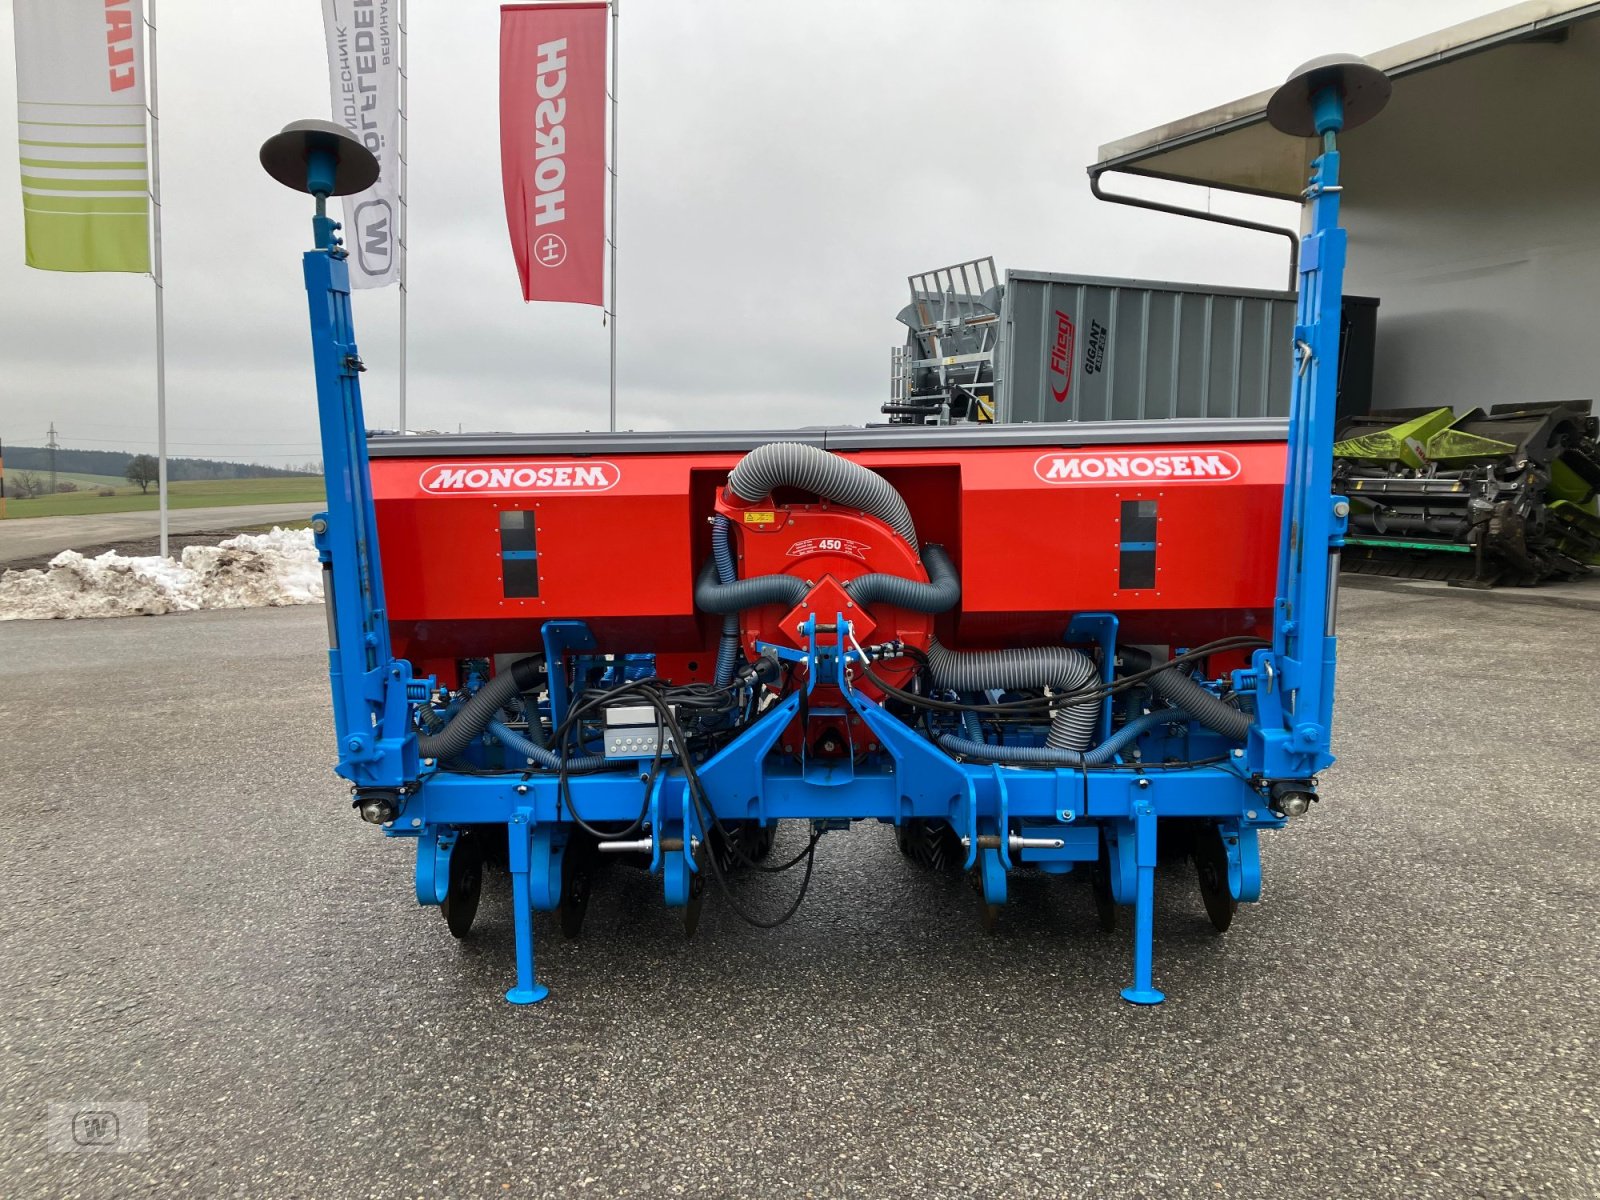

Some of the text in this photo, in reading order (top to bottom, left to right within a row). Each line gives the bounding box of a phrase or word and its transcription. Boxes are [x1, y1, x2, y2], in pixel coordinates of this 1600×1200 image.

[1051, 310, 1074, 376] Fliegl
[1085, 318, 1101, 375] GIGANT
[429, 467, 609, 489] MONOSEM
[1046, 455, 1231, 478] MONOSEM
[819, 540, 842, 550] 450
